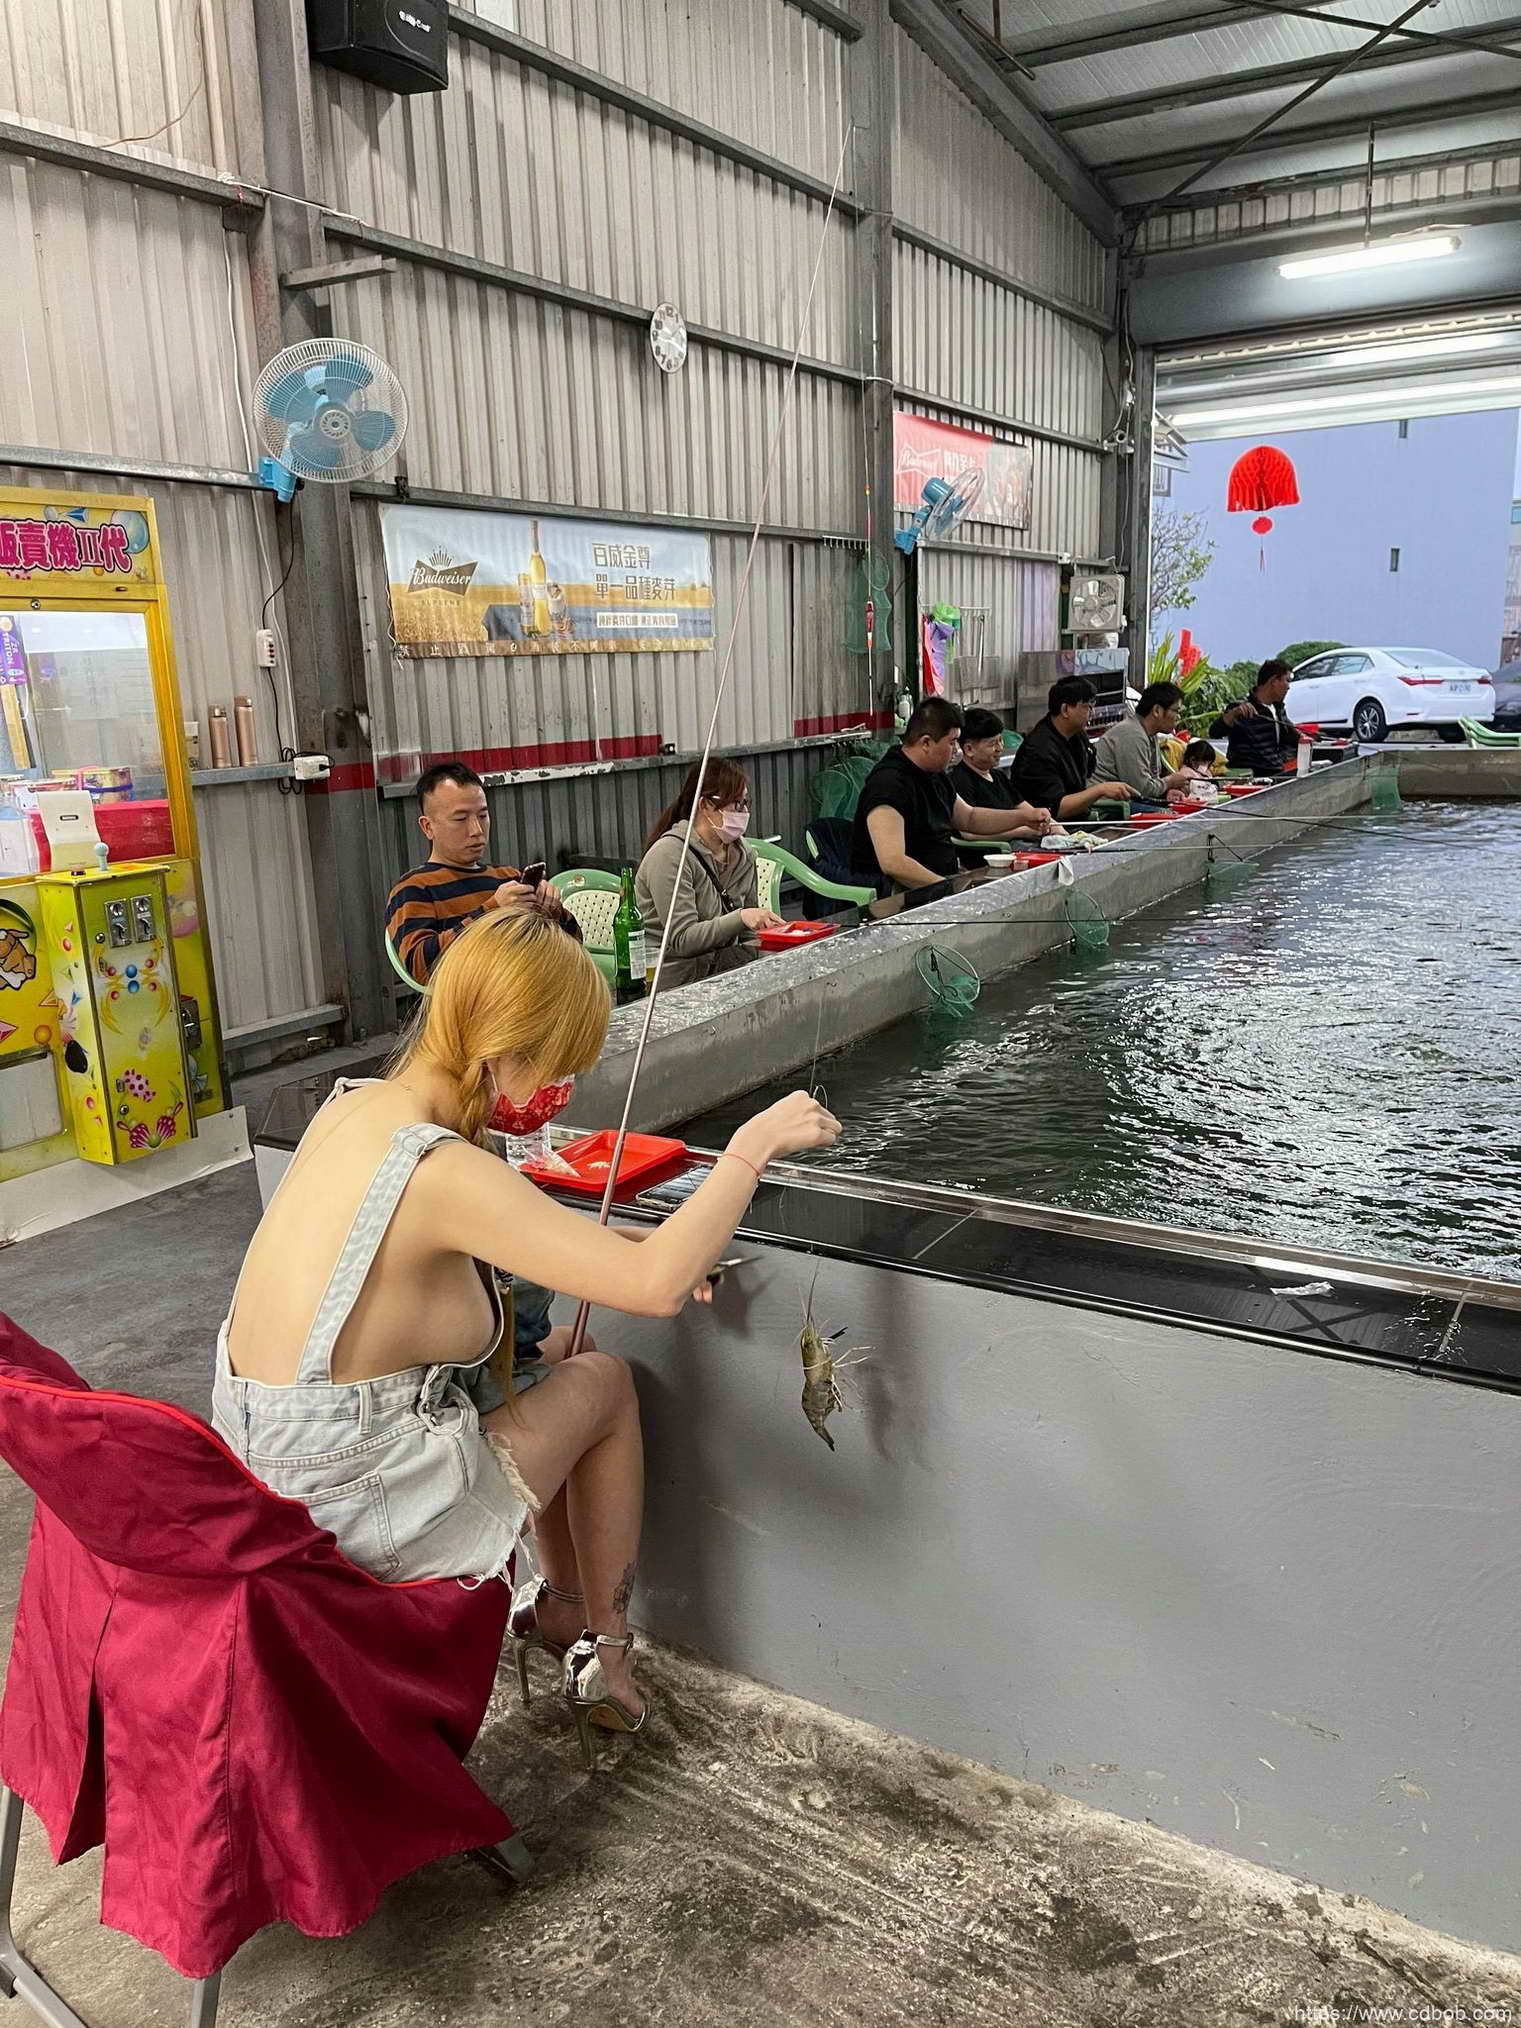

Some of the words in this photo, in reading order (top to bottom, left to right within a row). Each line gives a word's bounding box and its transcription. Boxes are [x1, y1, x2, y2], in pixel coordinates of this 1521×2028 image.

[592, 543, 650, 569] 百威金尊
[408, 567, 471, 585] Budweiser
